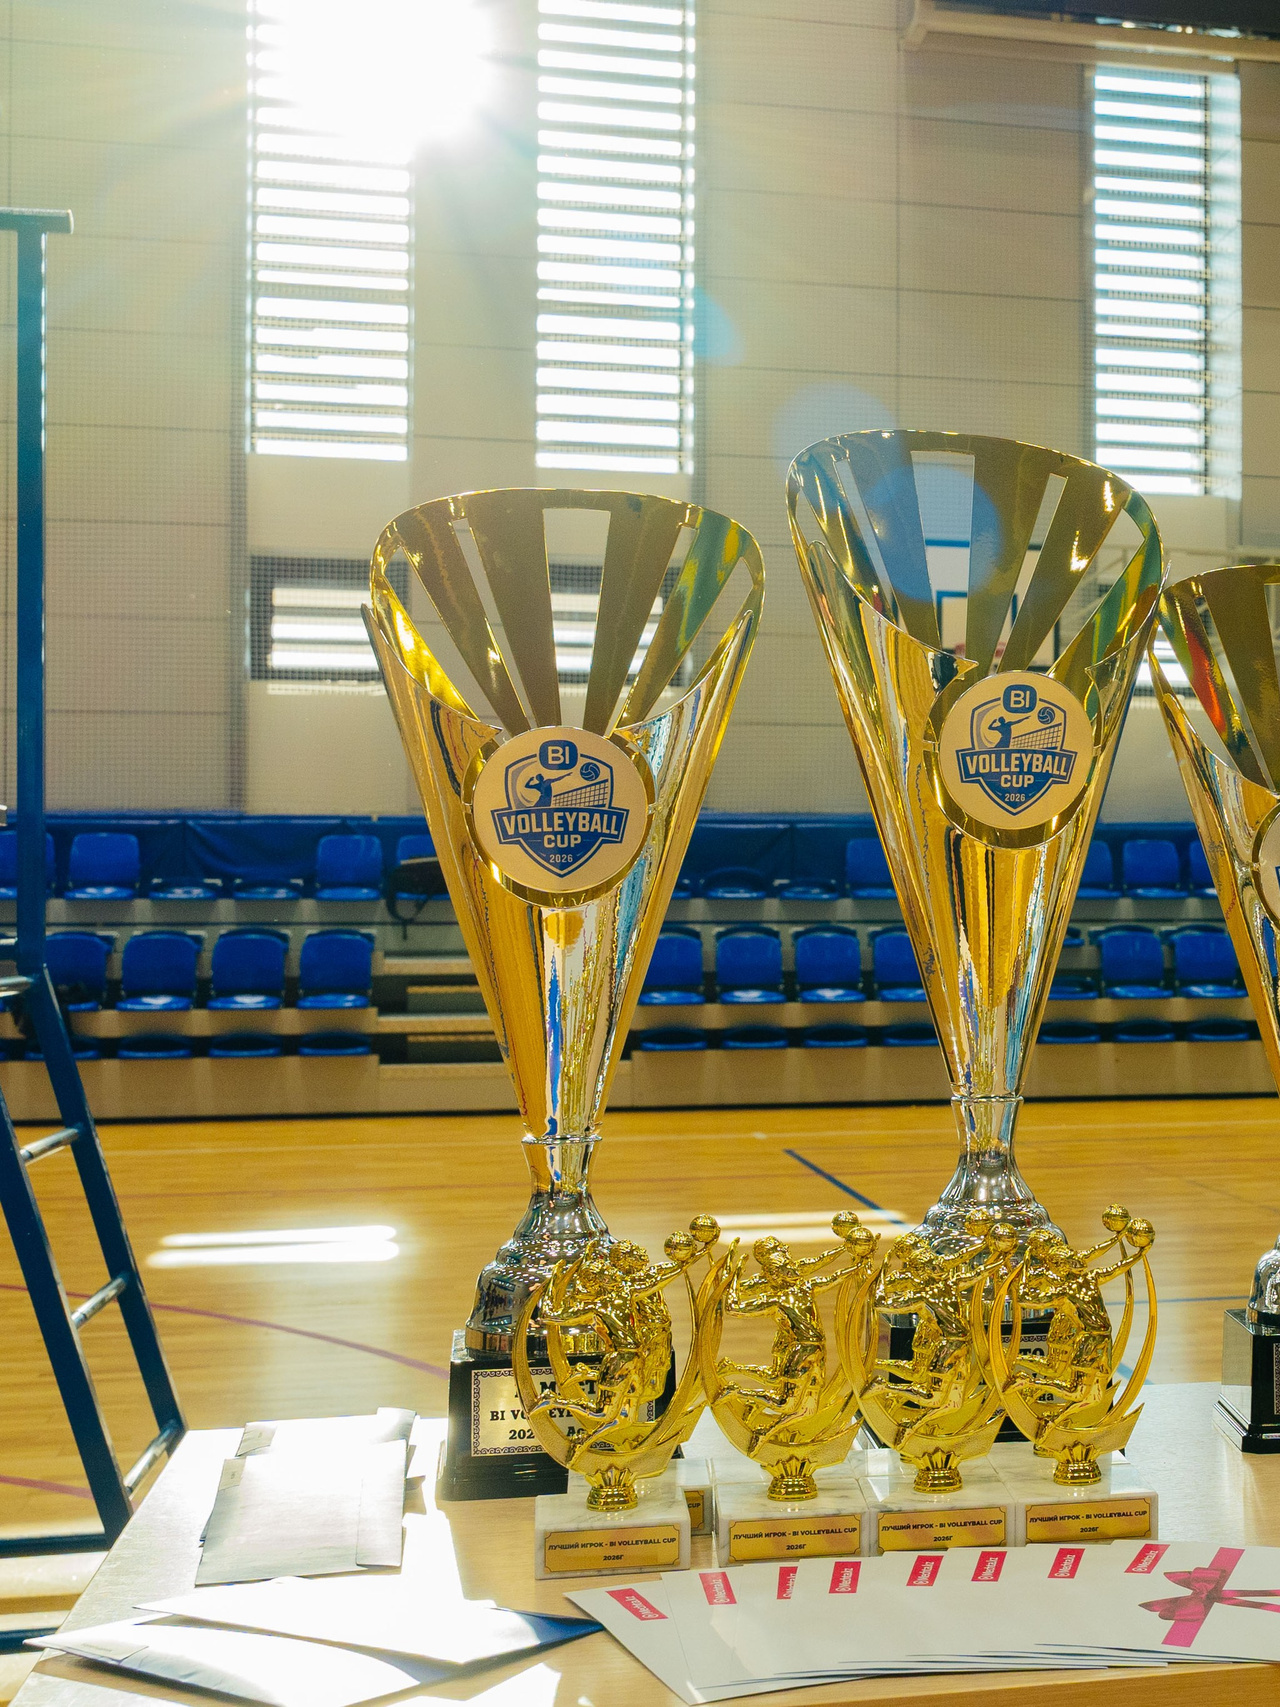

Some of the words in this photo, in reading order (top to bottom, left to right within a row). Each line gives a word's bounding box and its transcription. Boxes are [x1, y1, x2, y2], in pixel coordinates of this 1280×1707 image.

[1010, 690, 1030, 708] BI
[548, 746, 570, 764] BI
[966, 754, 1068, 776] VOLLEYBALL
[1000, 775, 1034, 788] CUP
[1005, 794, 1026, 802] 2026
[502, 811, 619, 836] VOLLEYBALL
[543, 834, 582, 848] CUP
[550, 854, 573, 863] 2026
[490, 1410, 506, 1421] BI
[509, 1430, 535, 1440] 202
